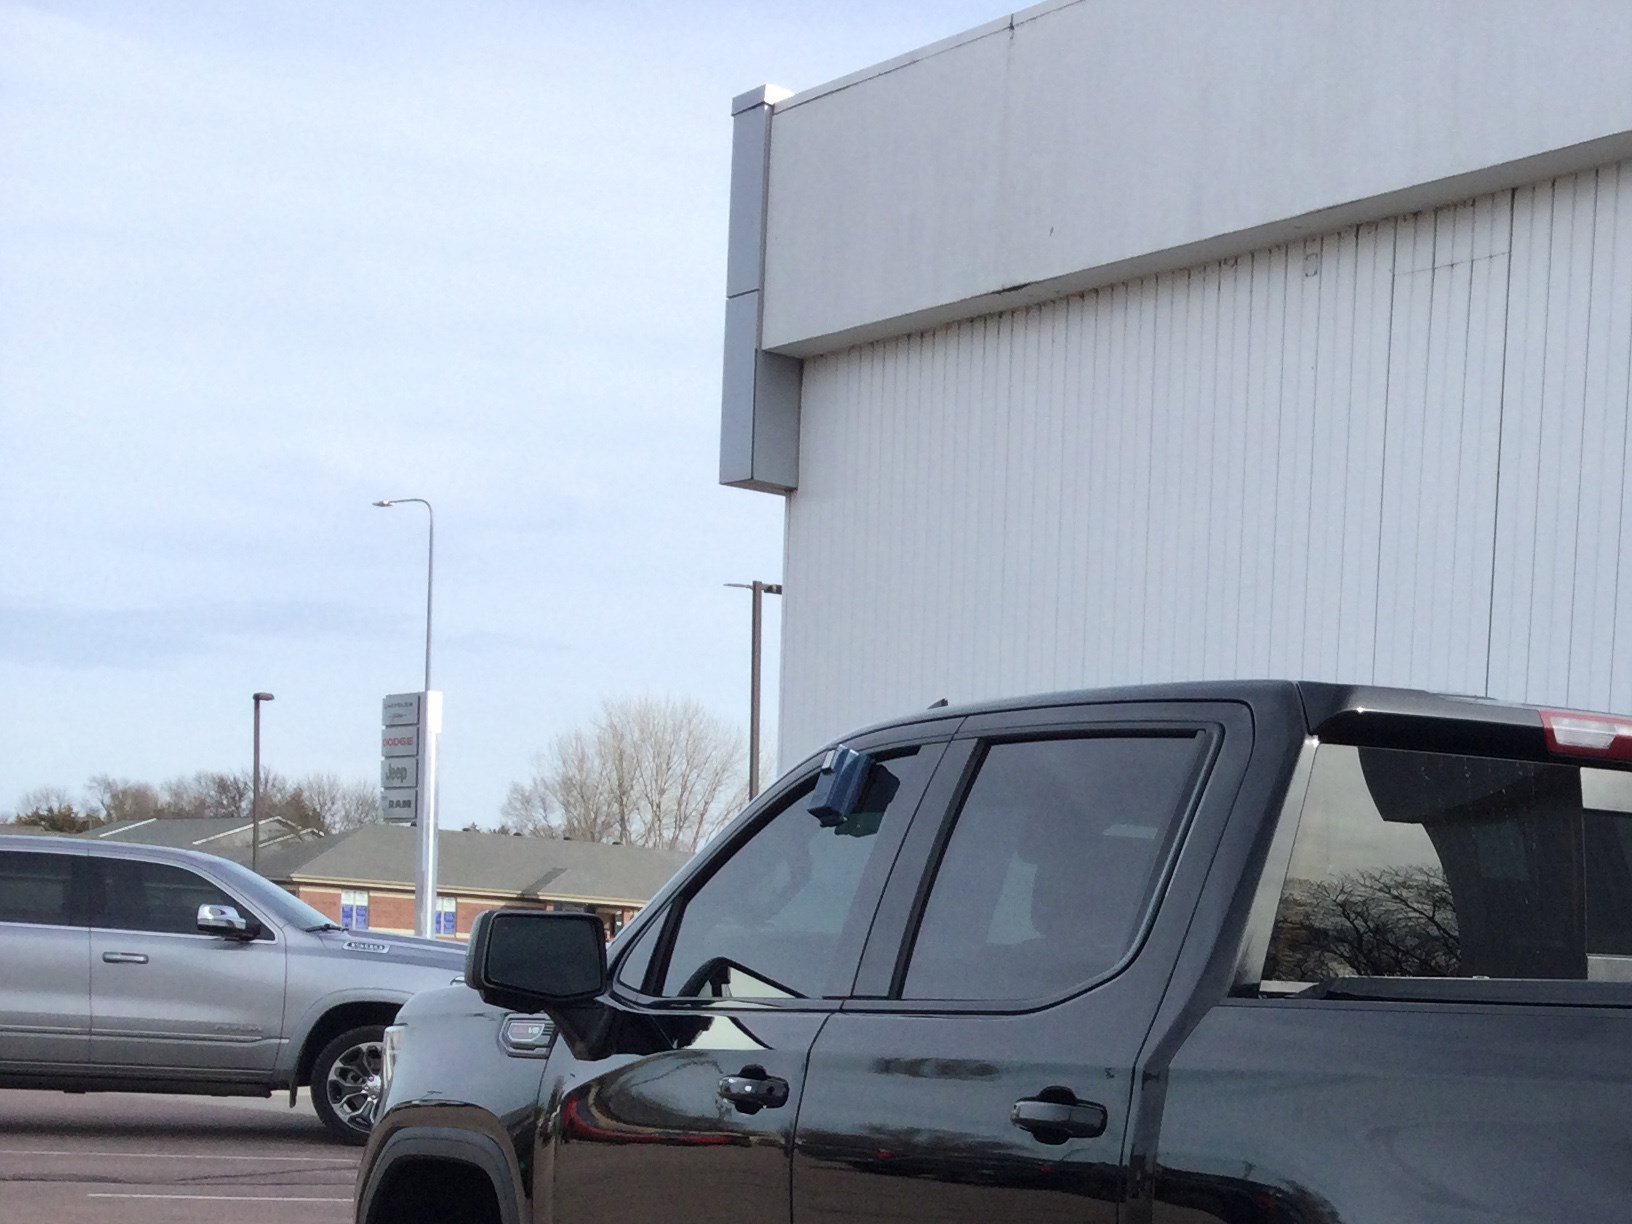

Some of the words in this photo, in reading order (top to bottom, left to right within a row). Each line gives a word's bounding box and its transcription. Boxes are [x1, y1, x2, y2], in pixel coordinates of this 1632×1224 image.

[383, 736, 414, 747] DODGE
[385, 763, 407, 783] Jeep
[388, 799, 412, 809] RAM
